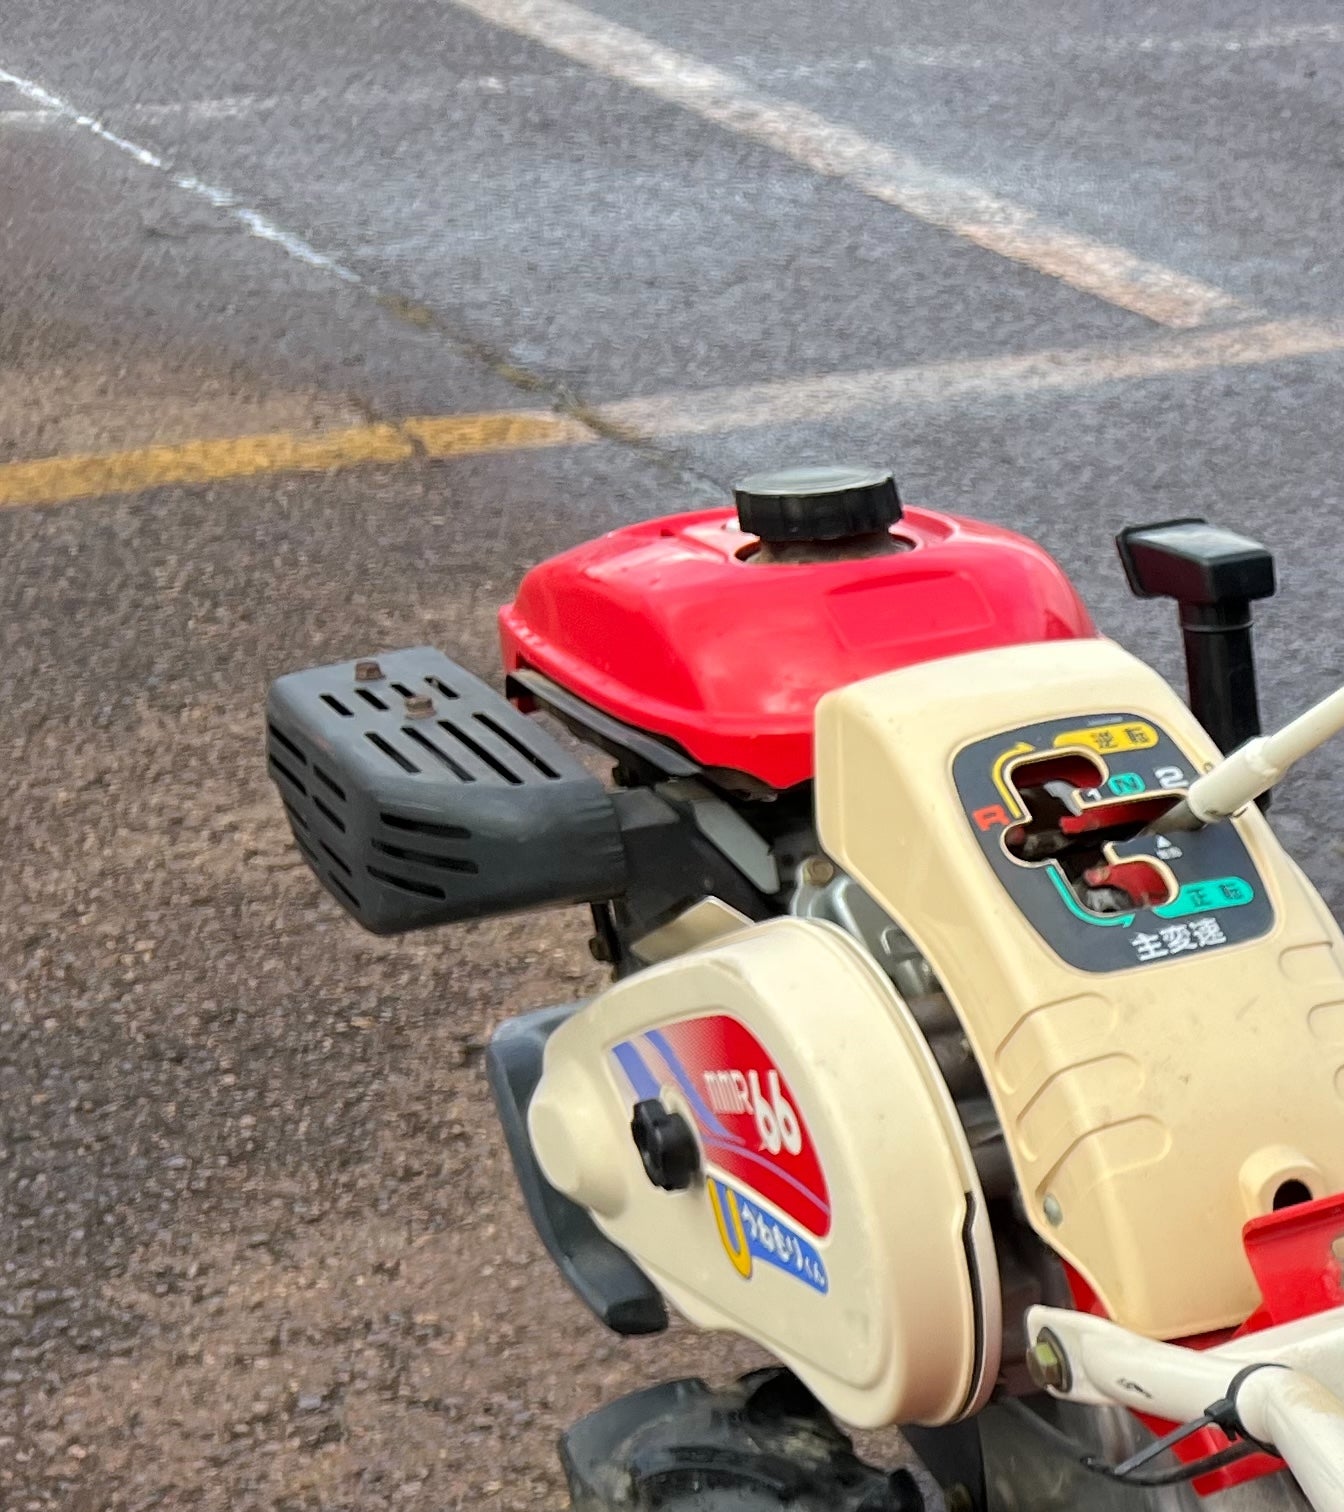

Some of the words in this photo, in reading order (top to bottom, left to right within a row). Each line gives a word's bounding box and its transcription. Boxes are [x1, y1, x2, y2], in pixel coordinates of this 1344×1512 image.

[1154, 765, 1189, 789] 2
[972, 803, 1010, 832] R
[1130, 917, 1227, 961] 主変速
